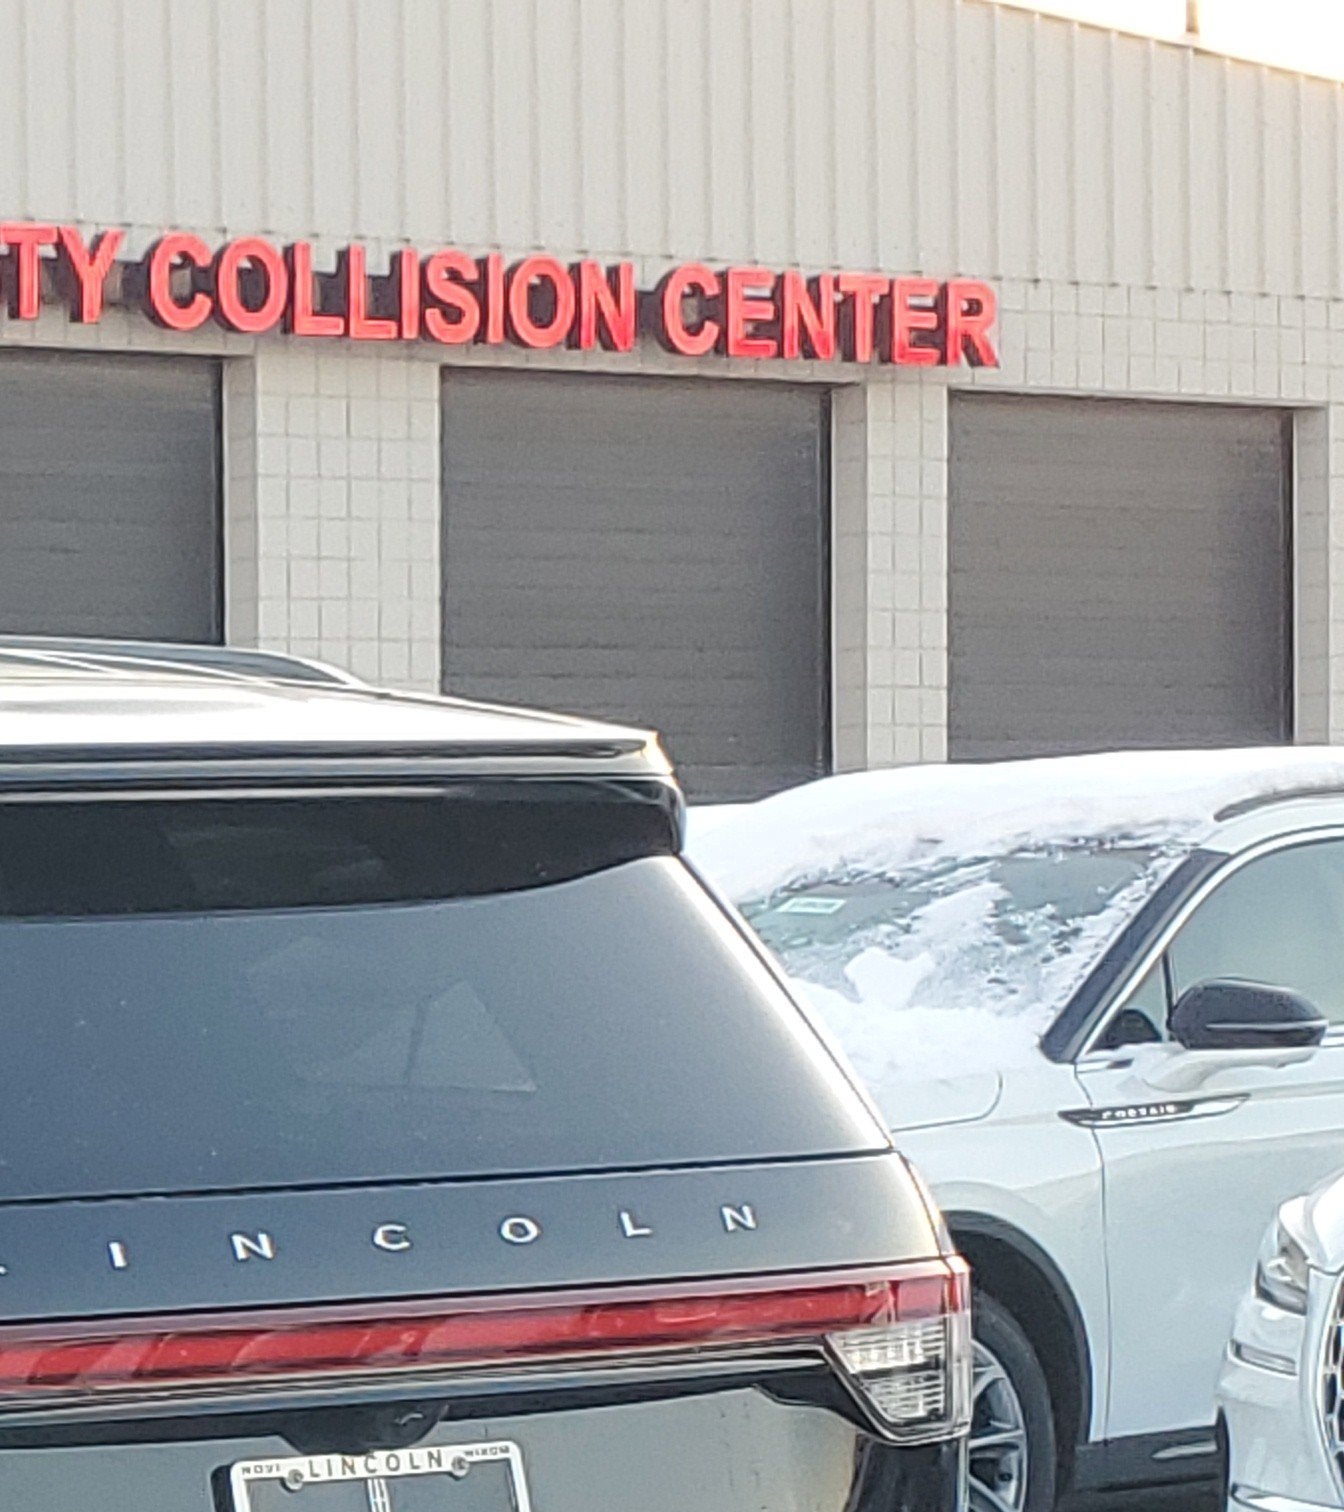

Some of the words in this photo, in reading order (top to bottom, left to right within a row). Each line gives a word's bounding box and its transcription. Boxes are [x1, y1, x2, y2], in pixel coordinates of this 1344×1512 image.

[150, 230, 636, 353] COLLISION
[663, 262, 1000, 369] CENTER
[308, 1449, 443, 1479] LINCOLN
